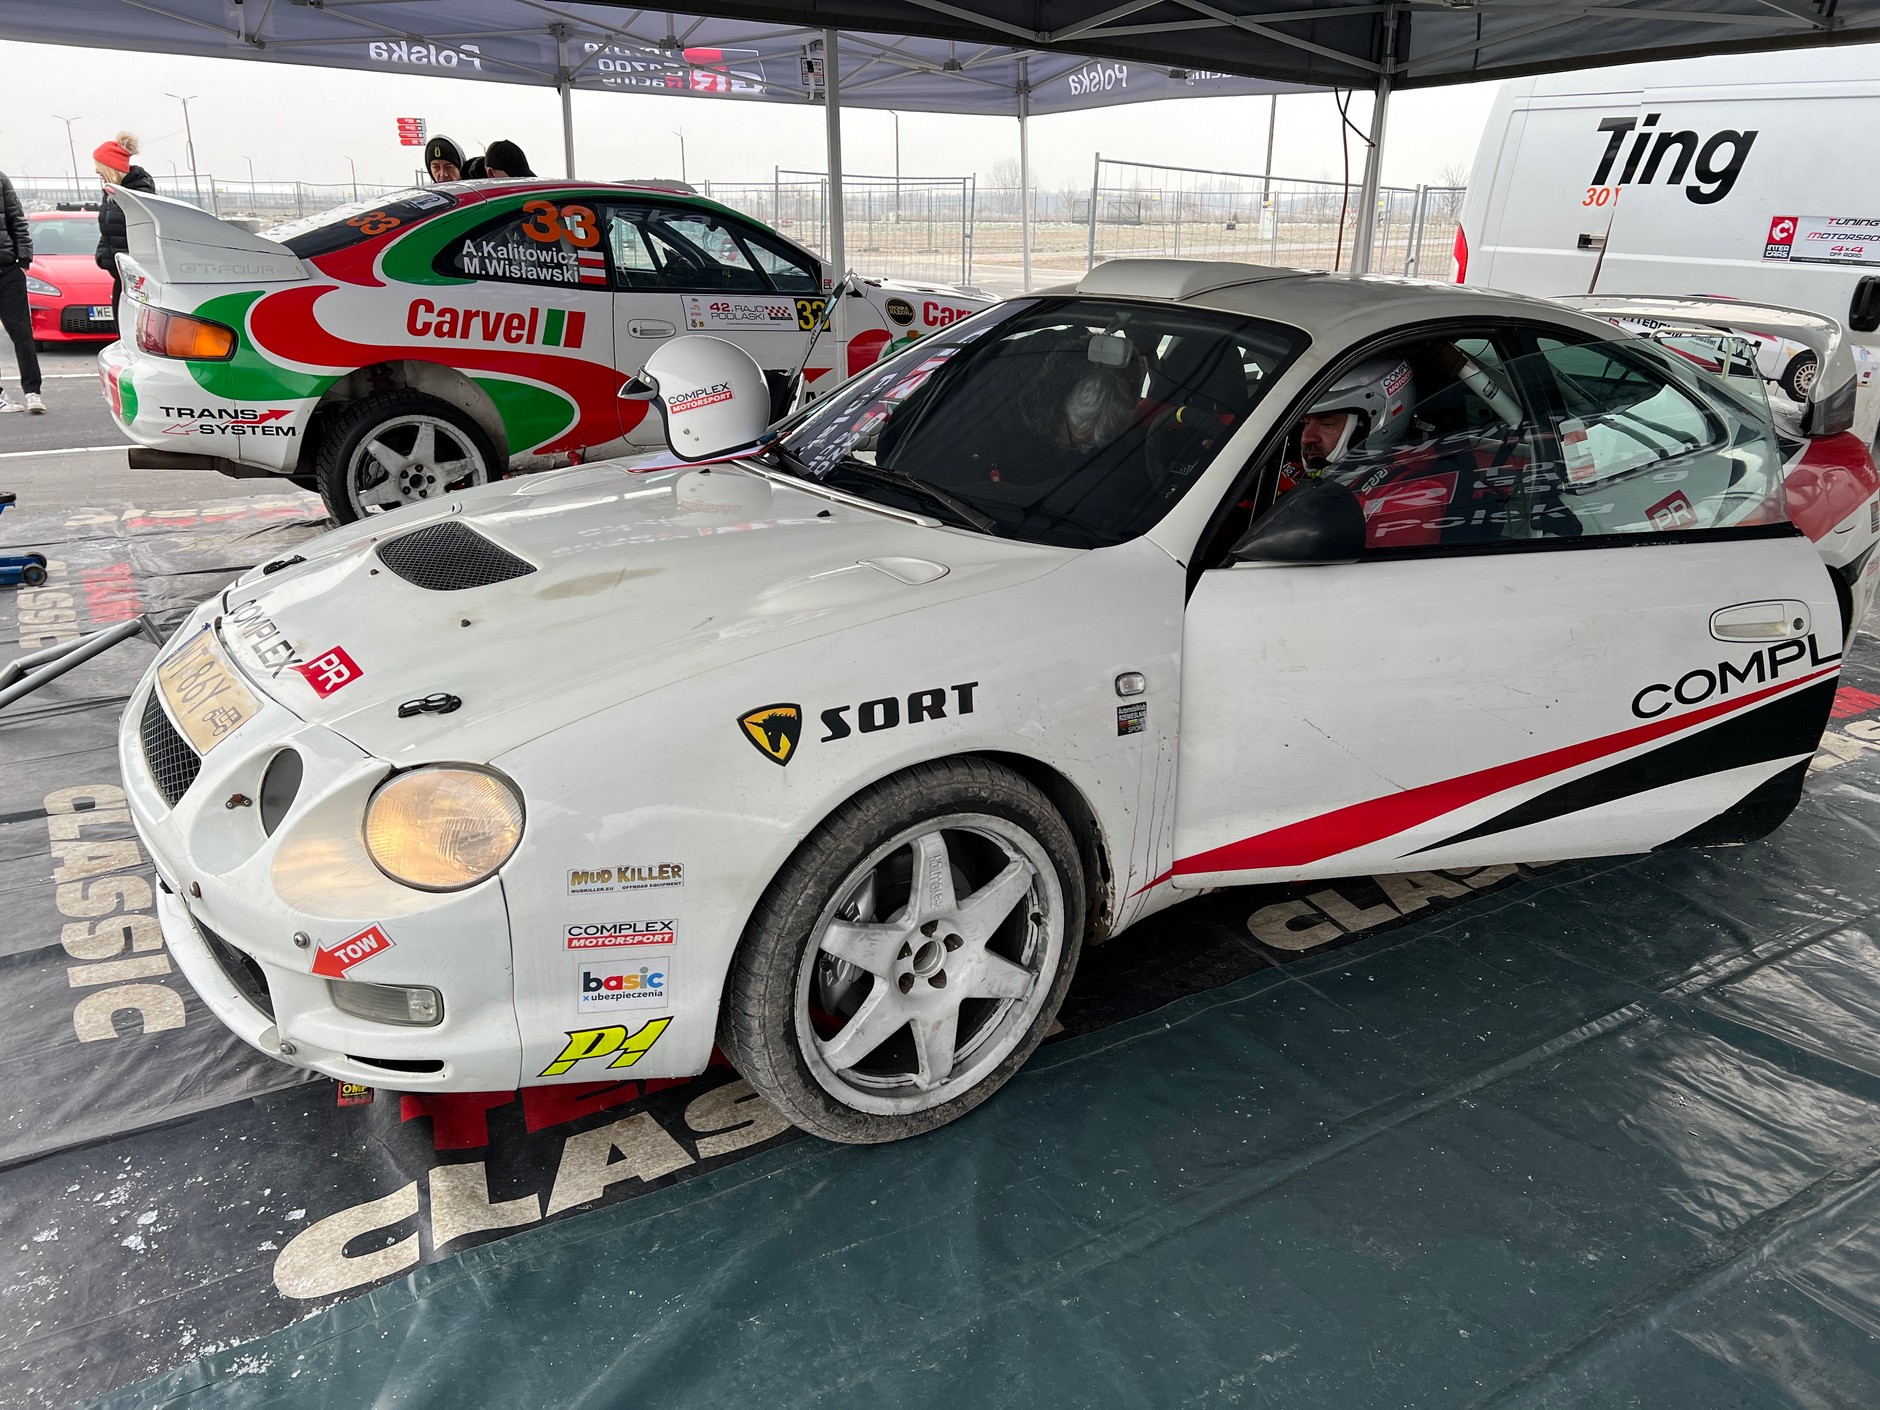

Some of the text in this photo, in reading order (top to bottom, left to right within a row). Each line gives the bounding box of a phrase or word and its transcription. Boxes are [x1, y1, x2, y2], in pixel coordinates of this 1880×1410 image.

[1591, 113, 1759, 205] Ting
[346, 211, 401, 235] 33
[521, 200, 600, 248] 33
[1827, 217, 1880, 227] TUNING
[1767, 244, 1789, 252] INTER
[1806, 231, 1880, 242] MOTORSPO
[462, 239, 578, 266] A.Kalitowicz
[463, 256, 579, 283] M.Wisławski
[94, 306, 112, 318] WE
[710, 312, 766, 321] PODLASKI
[734, 305, 764, 313] RAJD
[923, 301, 974, 328] Car
[406, 298, 539, 345] Carvel
[668, 382, 730, 405] COMPLEX
[672, 391, 731, 413] MOTORSPORT
[159, 406, 258, 420] TRANS
[199, 424, 297, 437] SYSTEM
[308, 652, 351, 691] PR
[1631, 633, 1843, 720] COMPL
[820, 681, 979, 743] SORT
[571, 863, 682, 886] MUD KILLER
[571, 886, 614, 894] MUDKILLER.EU
[43, 784, 186, 1043] CLASSIC
[568, 921, 674, 937] COMPLEX
[571, 934, 672, 947] MOTORSPORT
[334, 933, 379, 964] TOW
[583, 966, 664, 993] basic
[591, 989, 663, 1002] ubezpieczenia
